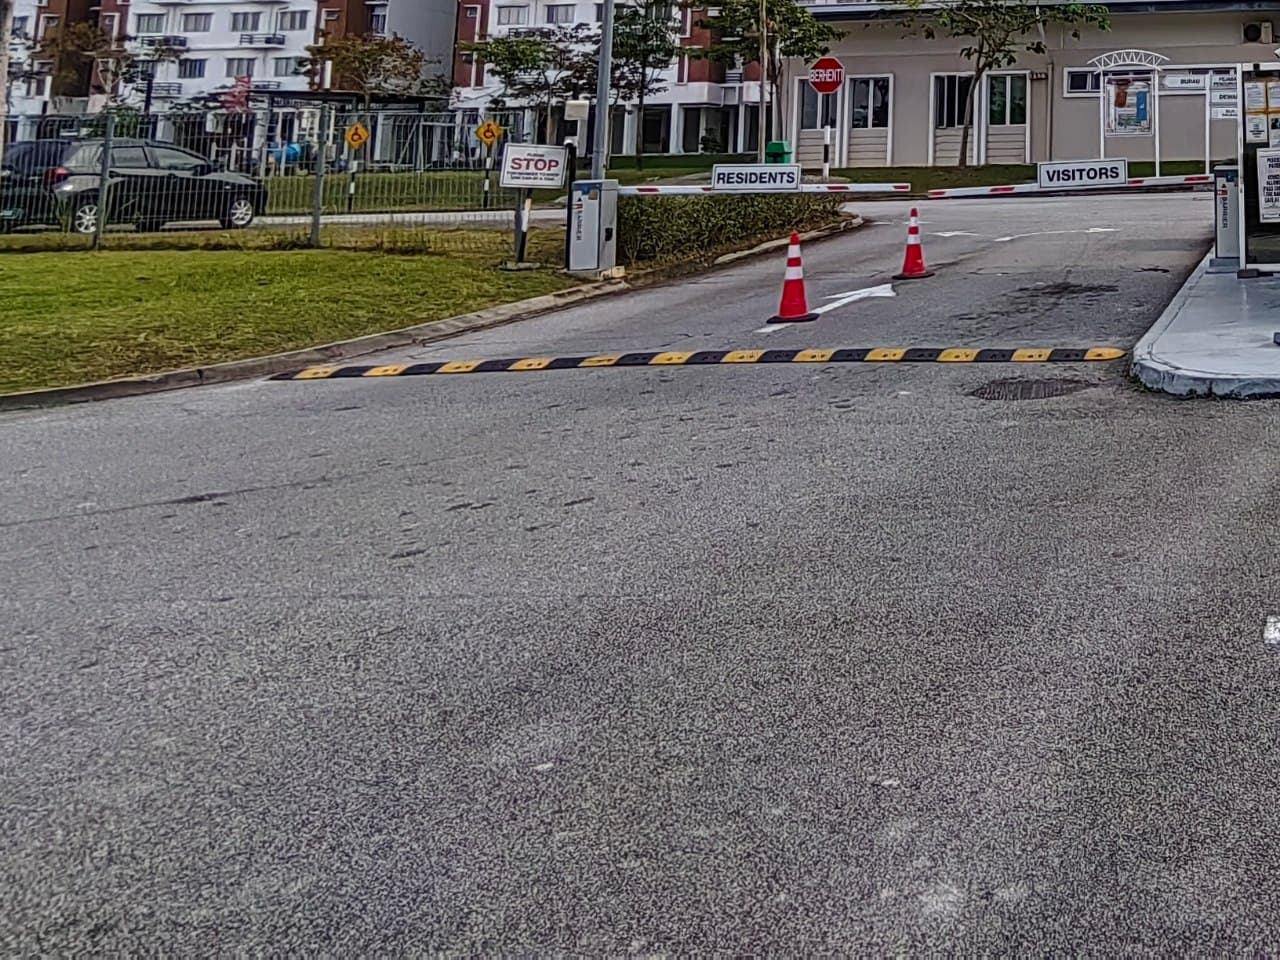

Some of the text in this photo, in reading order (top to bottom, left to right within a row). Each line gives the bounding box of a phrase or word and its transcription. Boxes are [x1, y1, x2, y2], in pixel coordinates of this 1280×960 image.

[810, 69, 844, 82] BERHENTI
[511, 157, 560, 171] STOP
[716, 171, 795, 185] RESIDENTS
[1046, 166, 1120, 182] VISITORS
